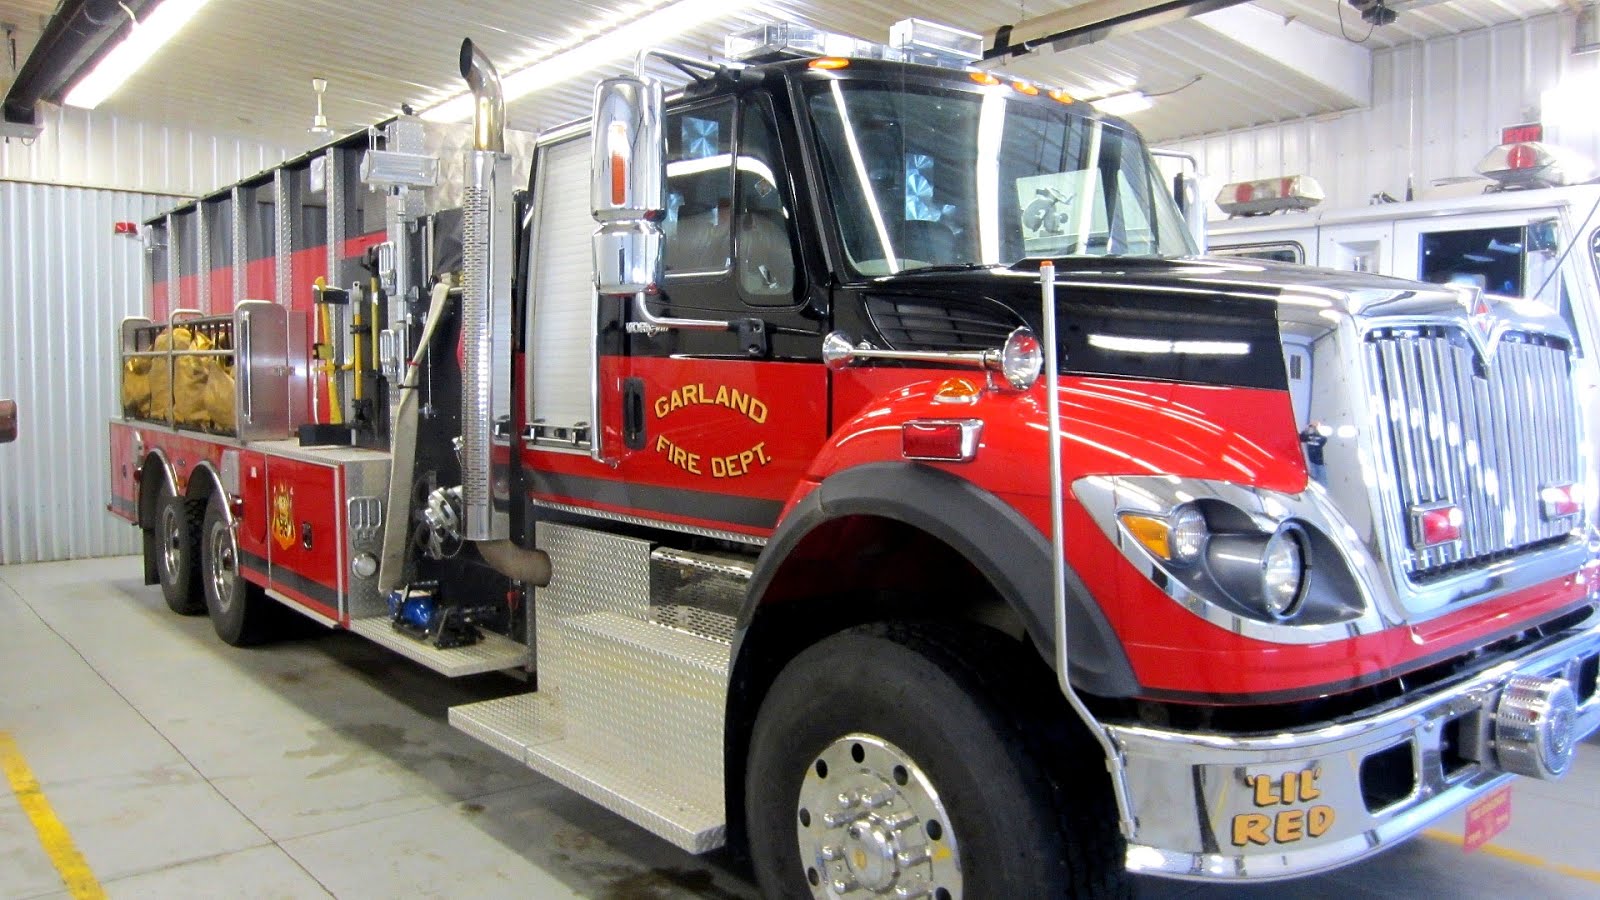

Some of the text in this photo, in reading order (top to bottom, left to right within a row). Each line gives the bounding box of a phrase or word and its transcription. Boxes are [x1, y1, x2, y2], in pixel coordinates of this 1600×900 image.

[654, 383, 768, 424] GARLAND
[656, 434, 771, 478] FIRE DEPT.
[1231, 804, 1335, 846] RED
